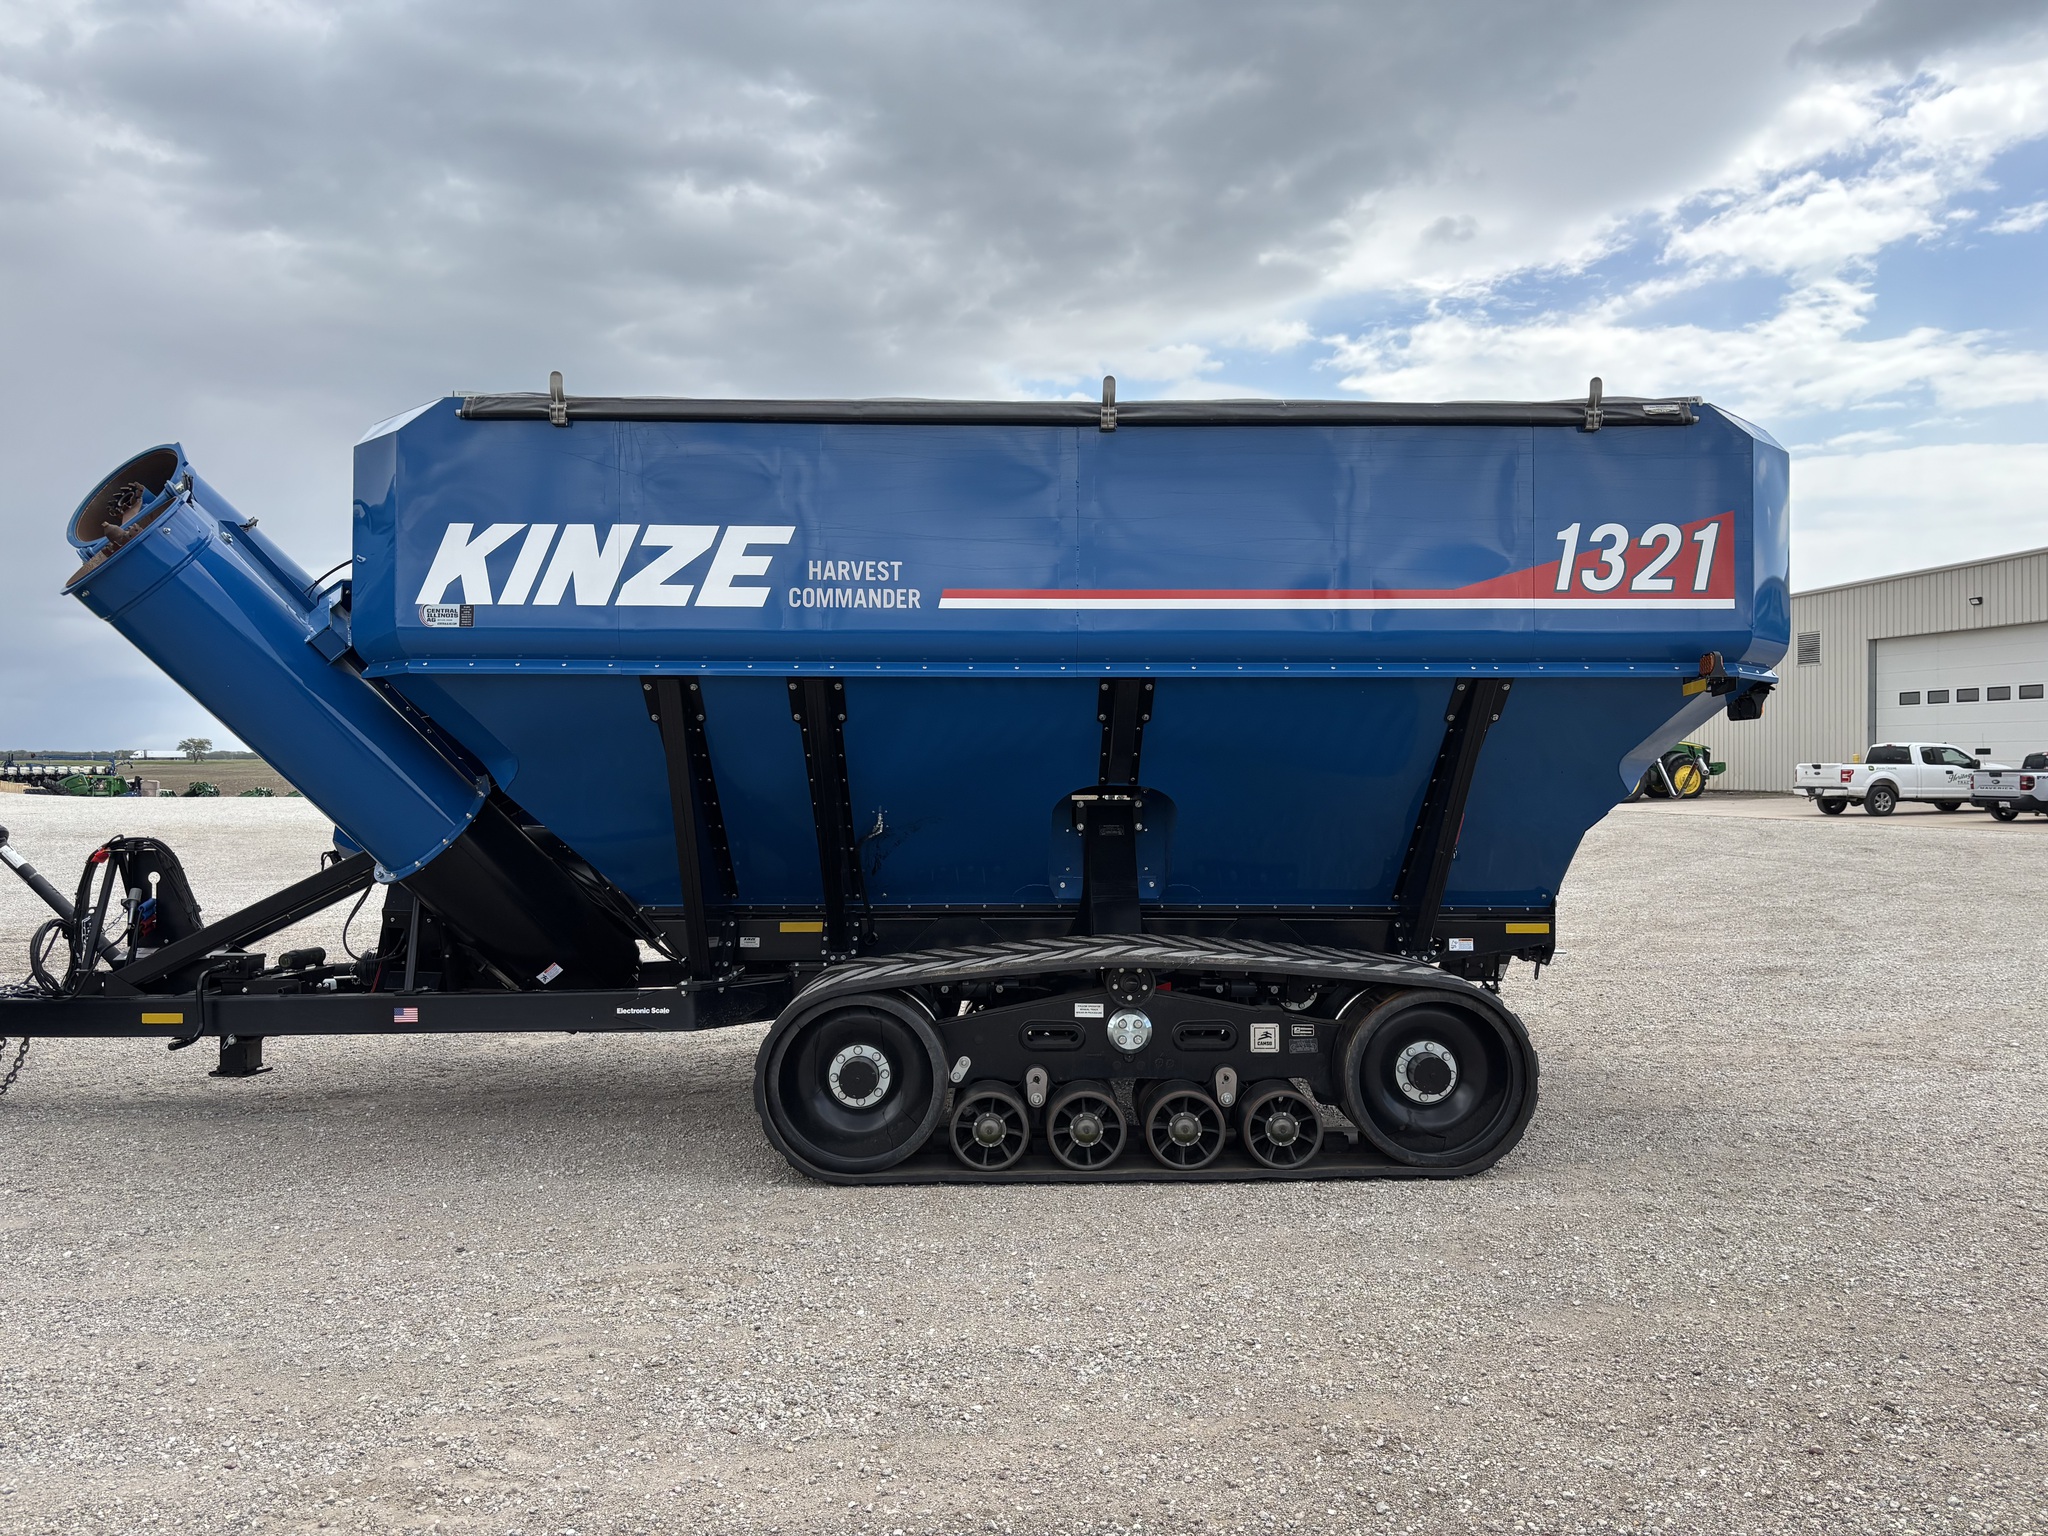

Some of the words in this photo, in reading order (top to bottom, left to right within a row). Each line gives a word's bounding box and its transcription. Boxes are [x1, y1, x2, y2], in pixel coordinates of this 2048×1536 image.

[415, 523, 796, 607] KINZE
[808, 560, 903, 581] HARVEST
[1555, 522, 1720, 592] 1321
[788, 587, 921, 609] COMMANDER
